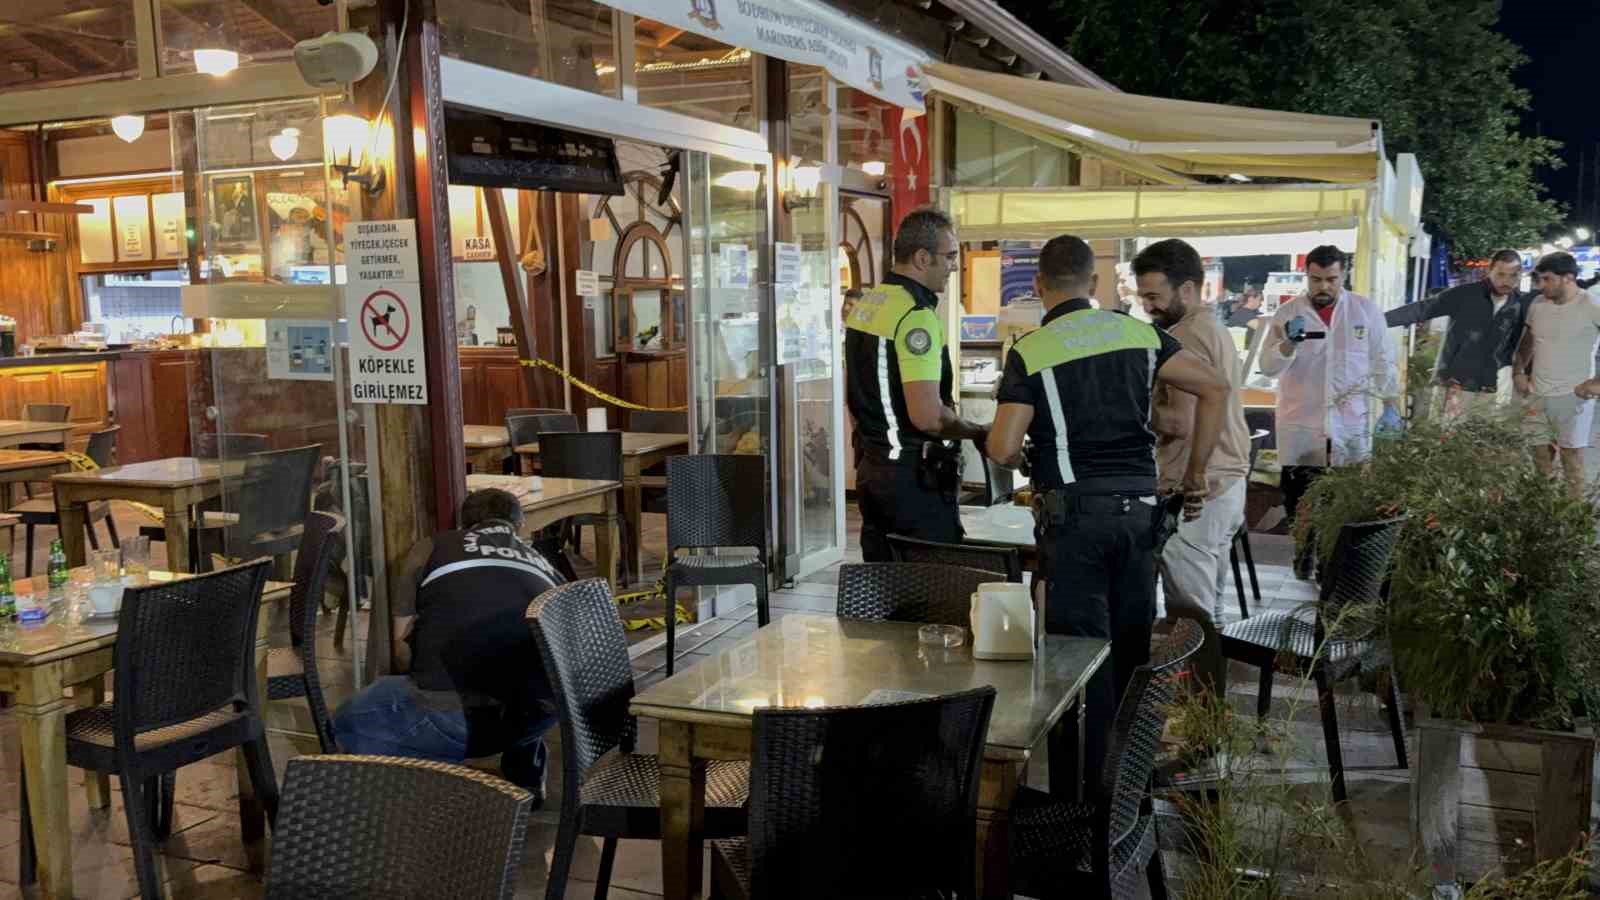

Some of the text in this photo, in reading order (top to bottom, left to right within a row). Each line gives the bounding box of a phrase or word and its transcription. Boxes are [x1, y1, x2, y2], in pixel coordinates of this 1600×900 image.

[465, 238, 490, 250] KASA
[359, 355, 415, 373] KÖPEKLE
[354, 380, 423, 400] GİRİLEMEZ
